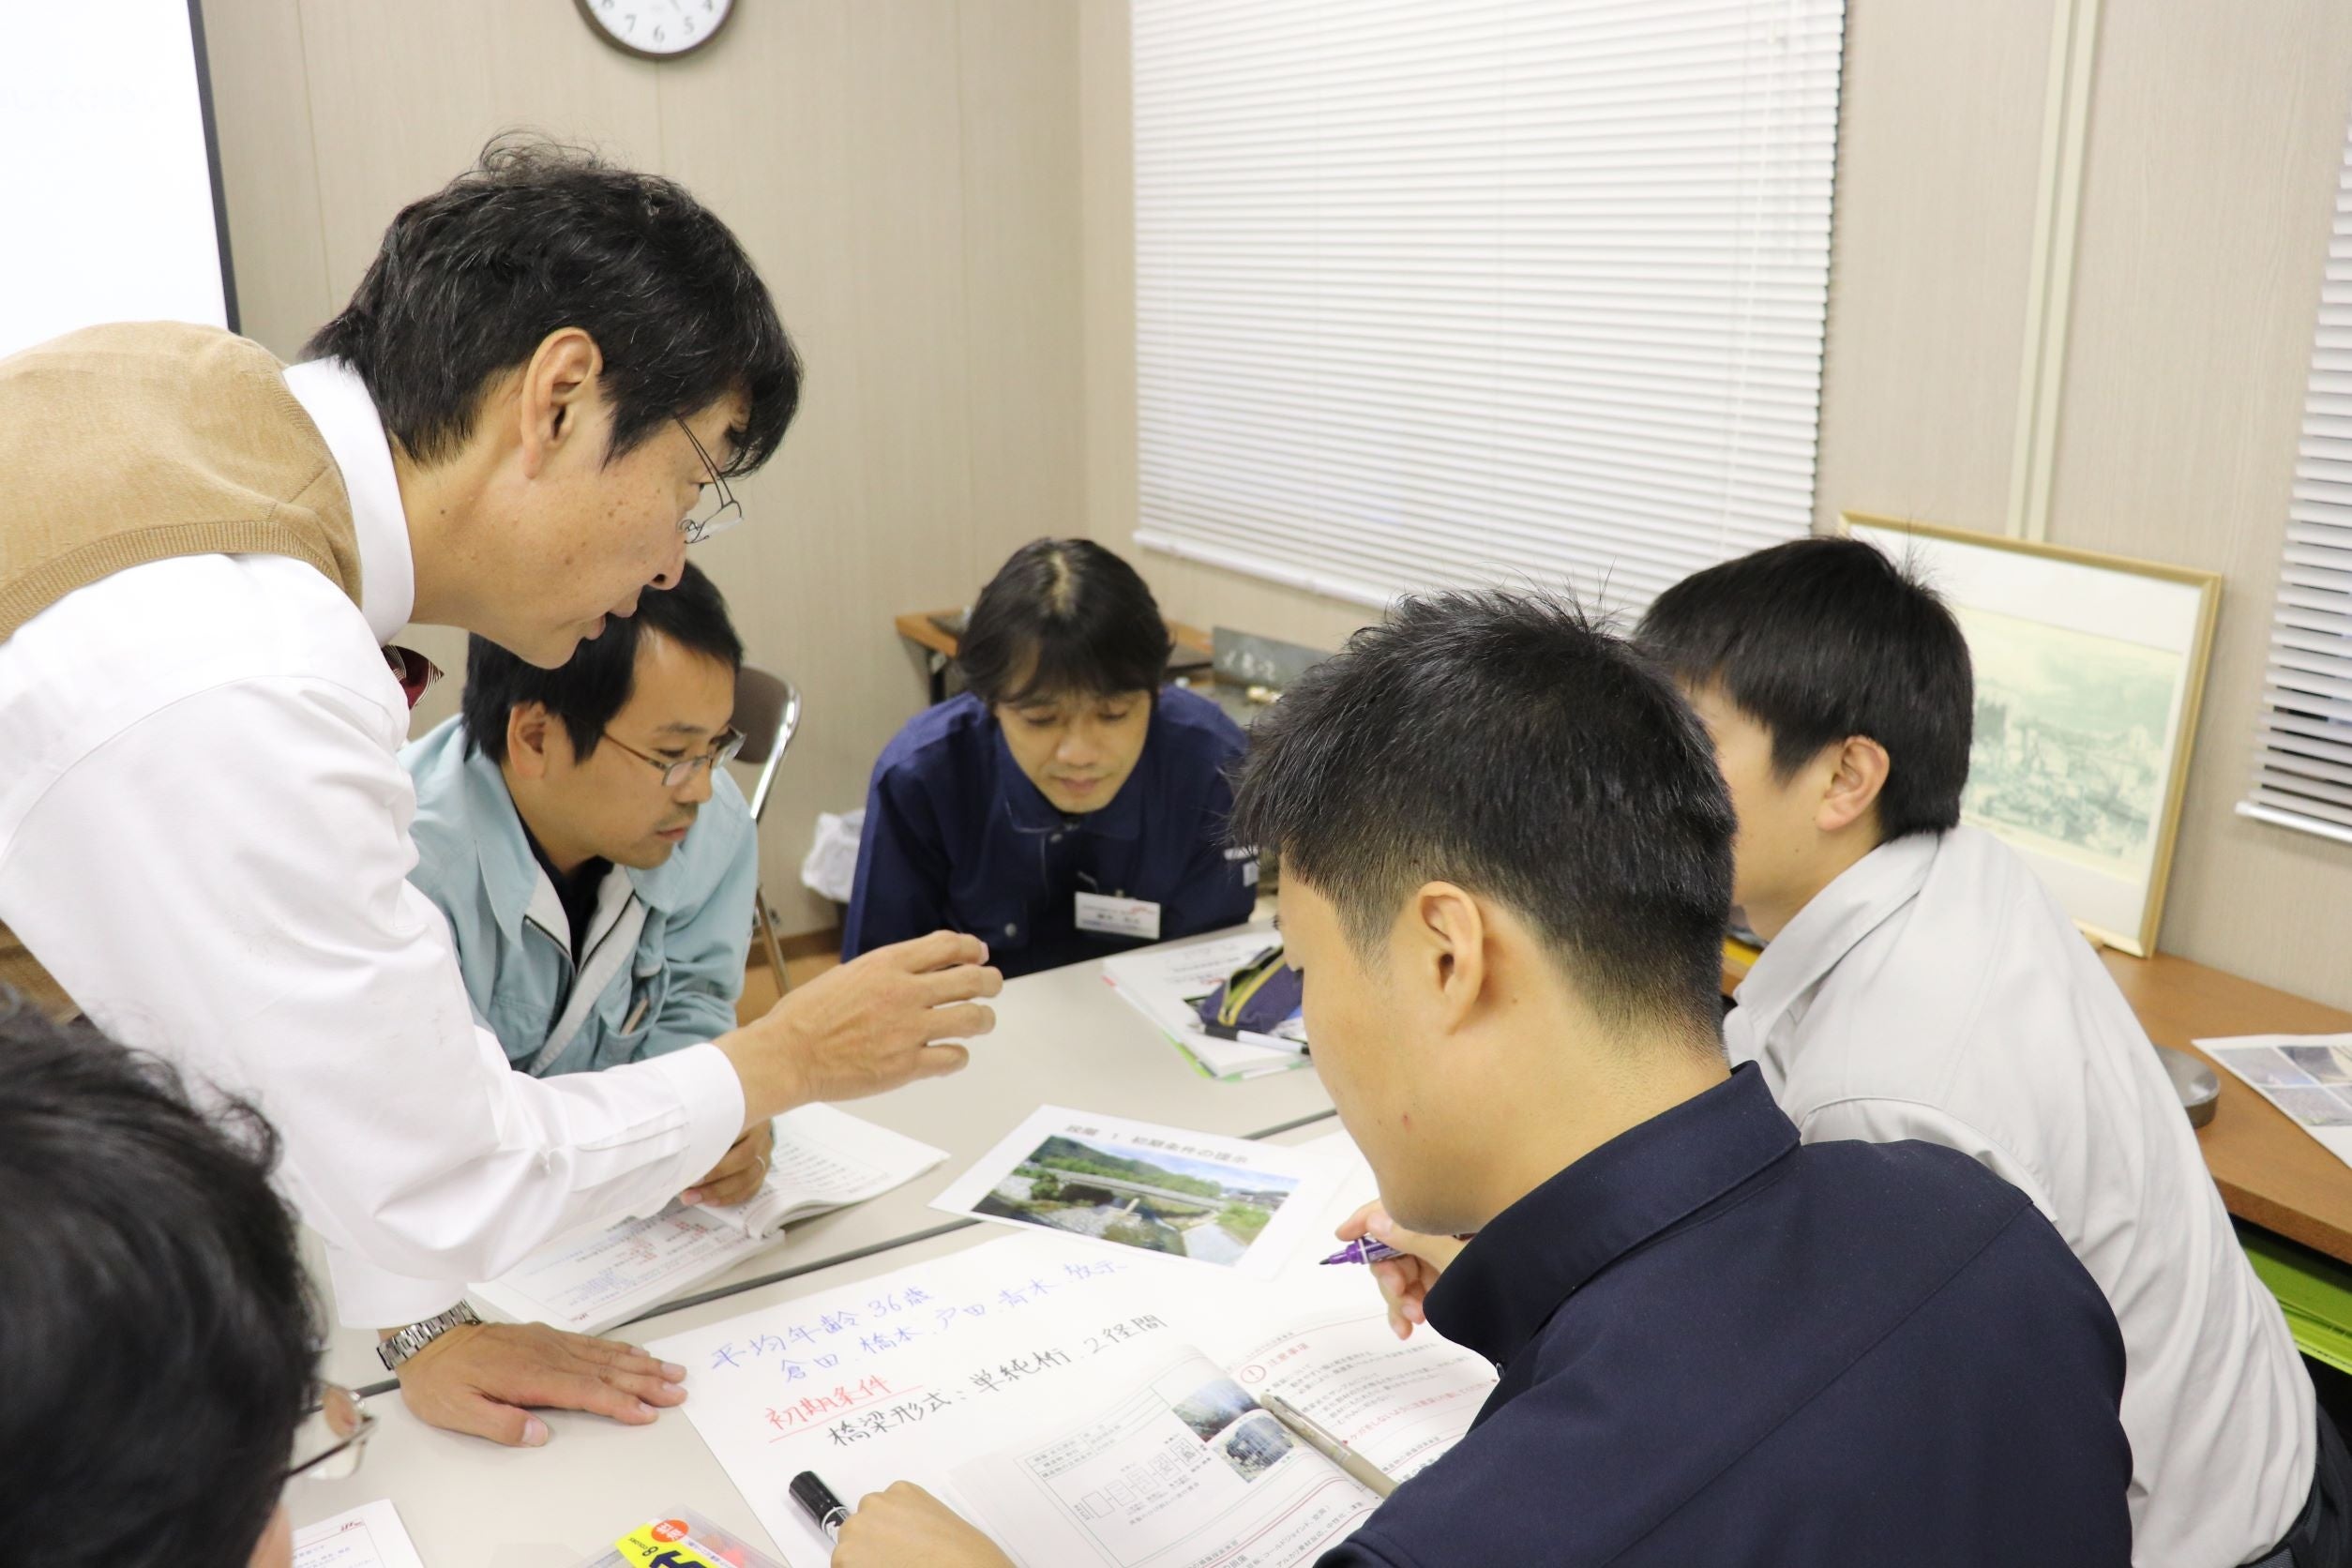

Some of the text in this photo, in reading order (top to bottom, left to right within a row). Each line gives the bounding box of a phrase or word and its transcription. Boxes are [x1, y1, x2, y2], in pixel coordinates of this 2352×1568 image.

[624, 13, 638, 33] 7
[683, 15, 695, 35] 5
[653, 25, 665, 43] 6
[765, 1374, 892, 1431] 初期条件
[656, 1521, 686, 1542] 油性
[641, 1545, 659, 1557] 8
